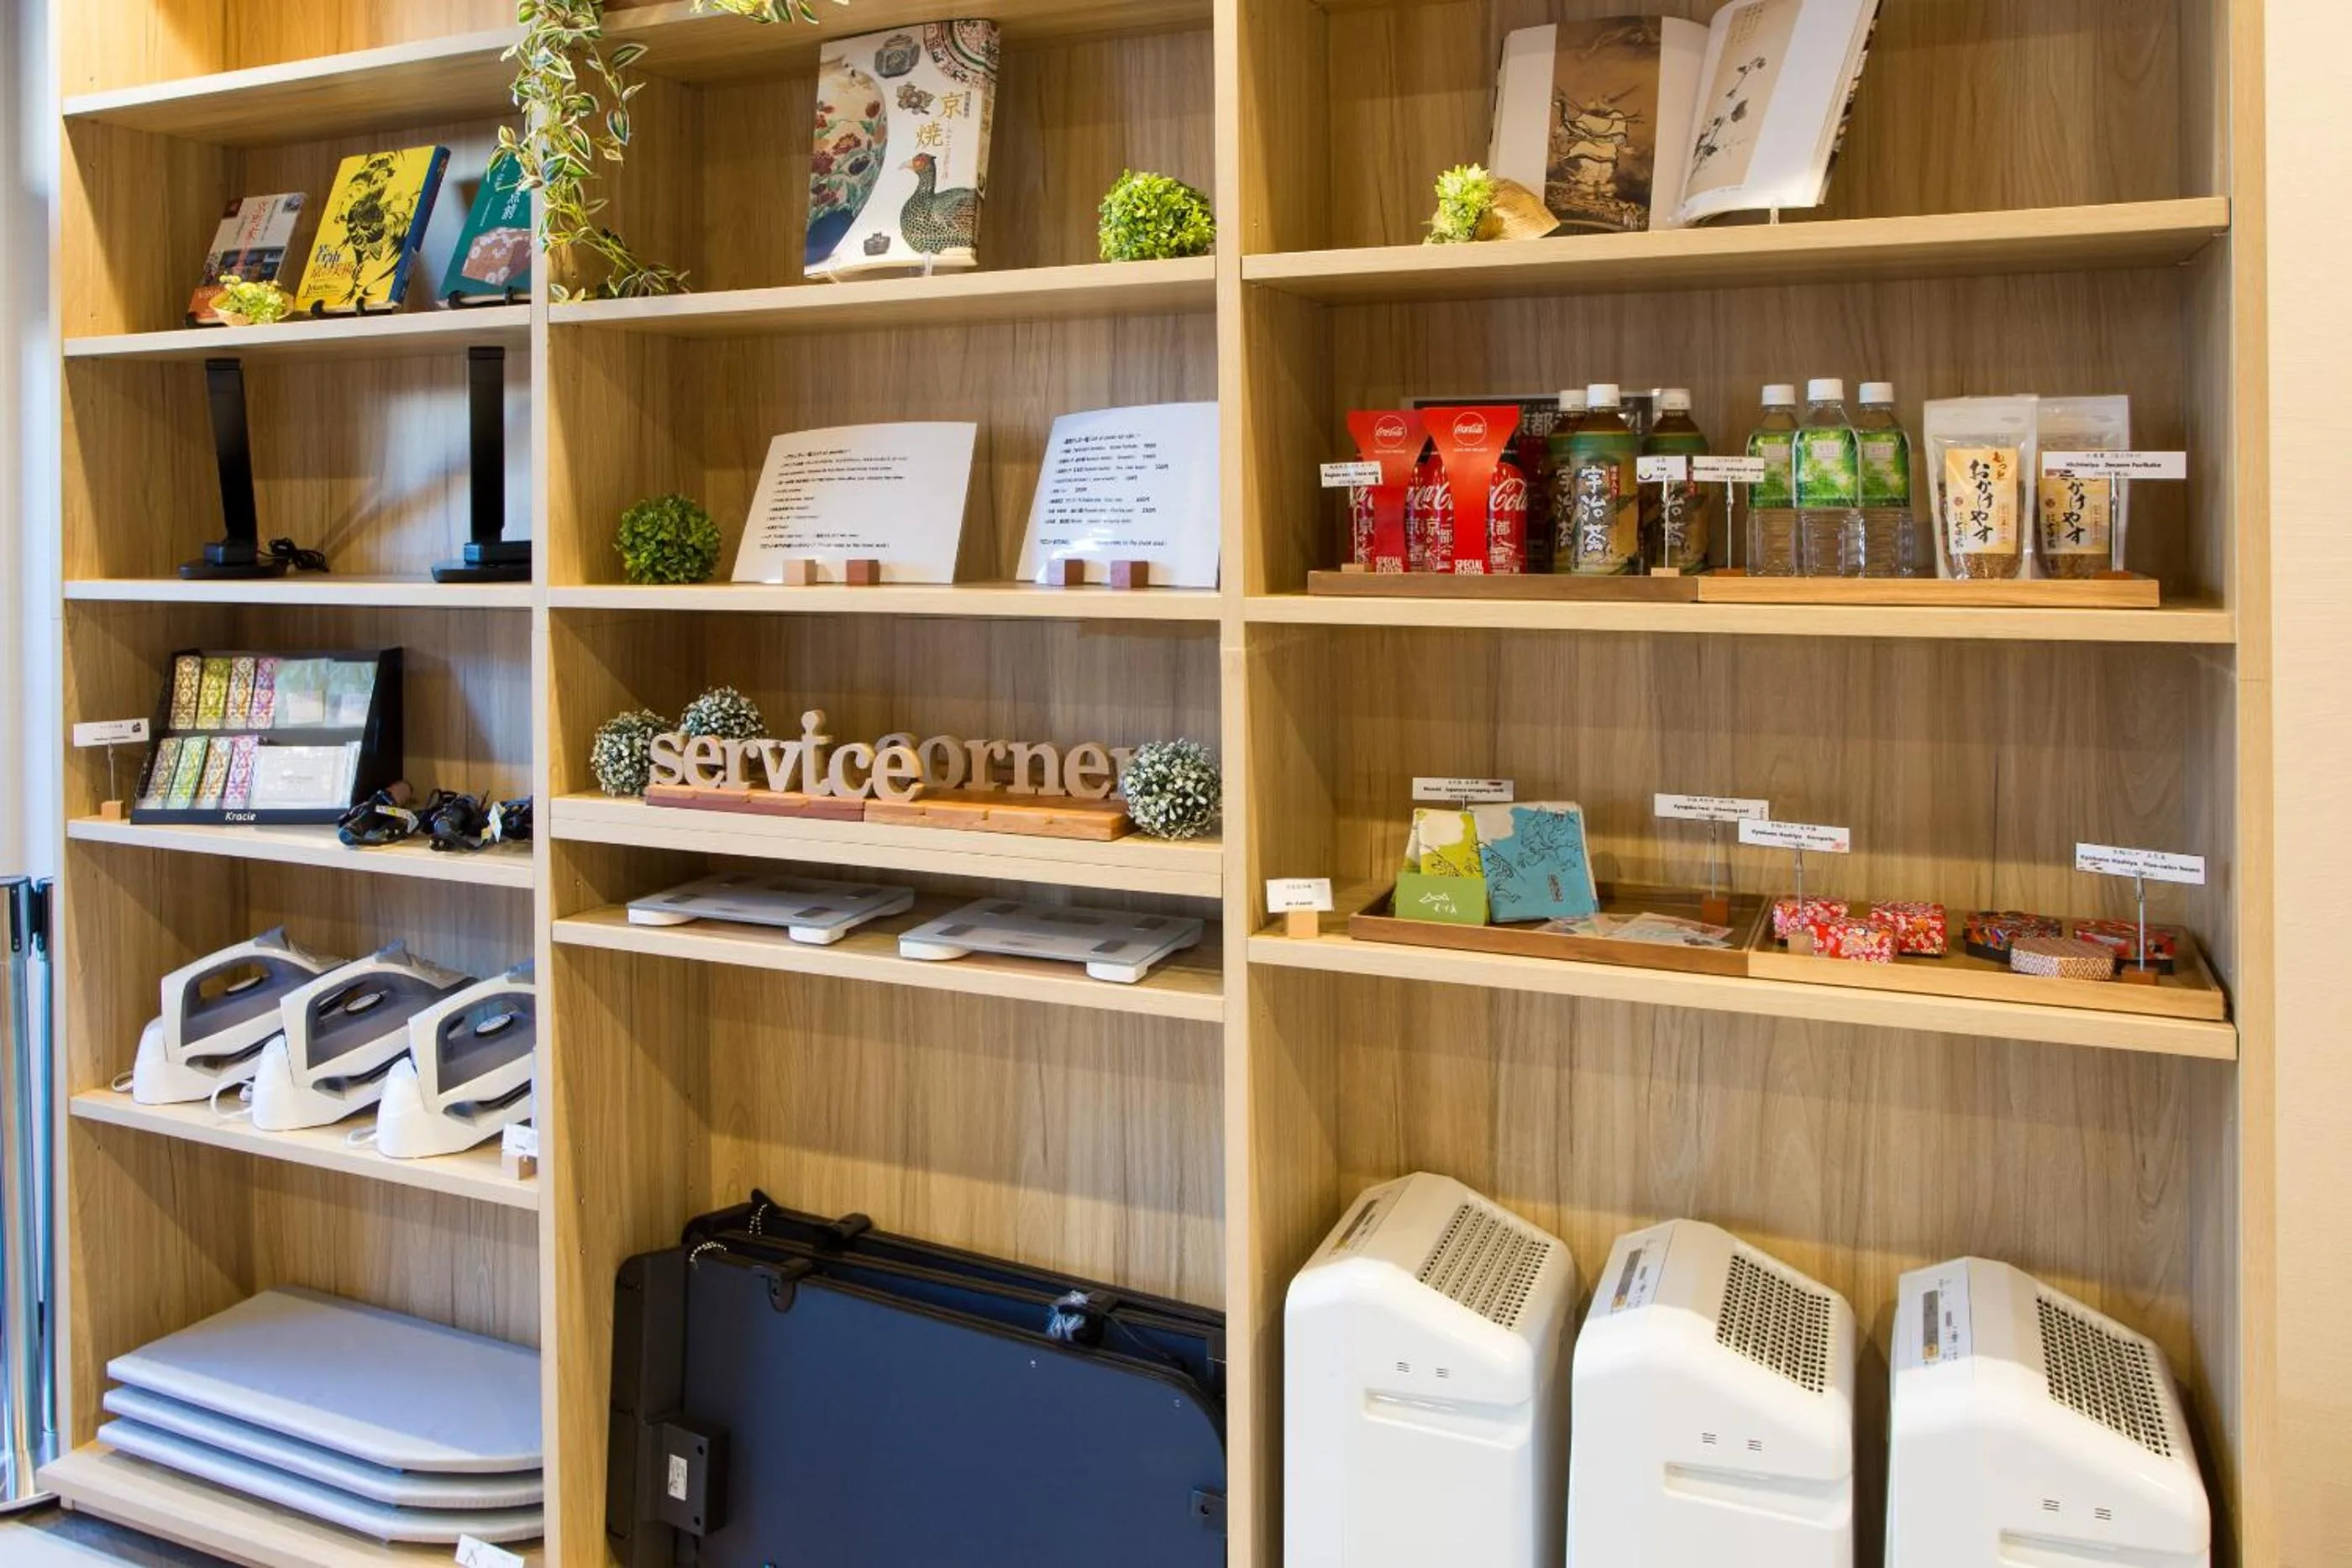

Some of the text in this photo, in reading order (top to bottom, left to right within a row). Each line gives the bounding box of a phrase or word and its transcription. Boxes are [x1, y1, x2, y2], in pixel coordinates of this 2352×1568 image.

[1580, 464, 1607, 552] 宇治茶
[1969, 459, 1993, 544] おかけやす
[2062, 478, 2086, 545] かけやす
[649, 710, 925, 802] service
[224, 810, 257, 821] Kracie
